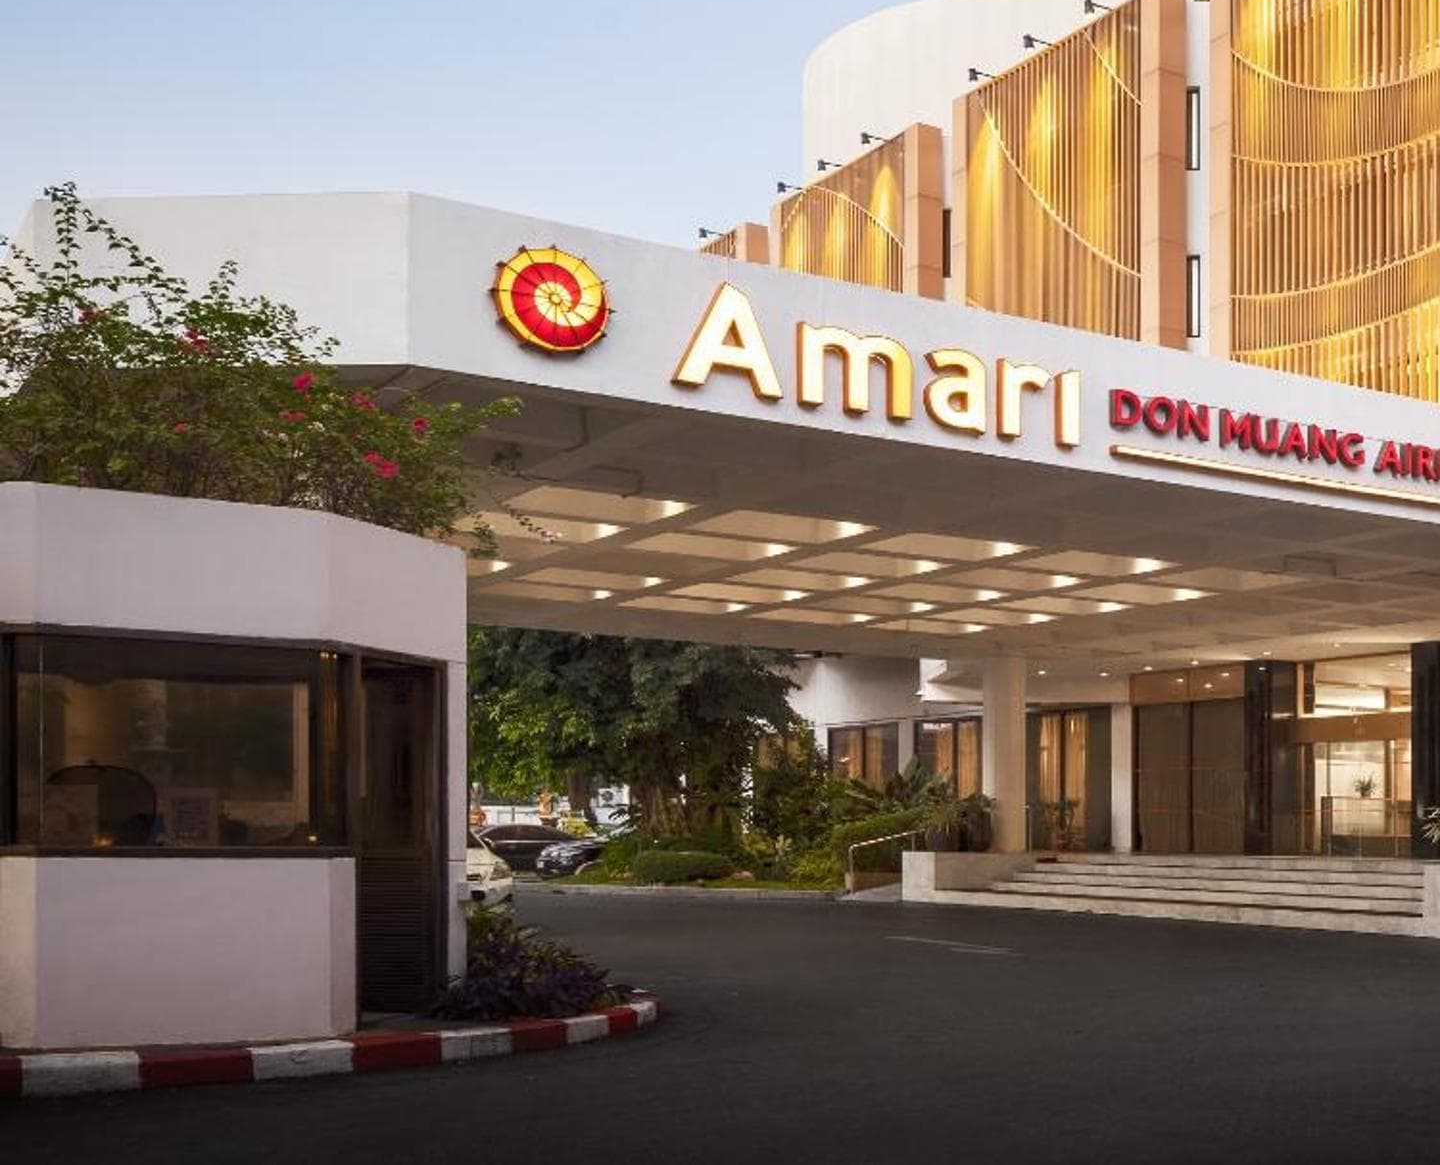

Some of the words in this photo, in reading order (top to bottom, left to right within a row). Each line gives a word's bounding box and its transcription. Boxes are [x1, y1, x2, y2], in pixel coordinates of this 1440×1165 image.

[670, 281, 1082, 448] Amari
[1109, 388, 1210, 441] DON
[1219, 408, 1366, 467] MUANG
